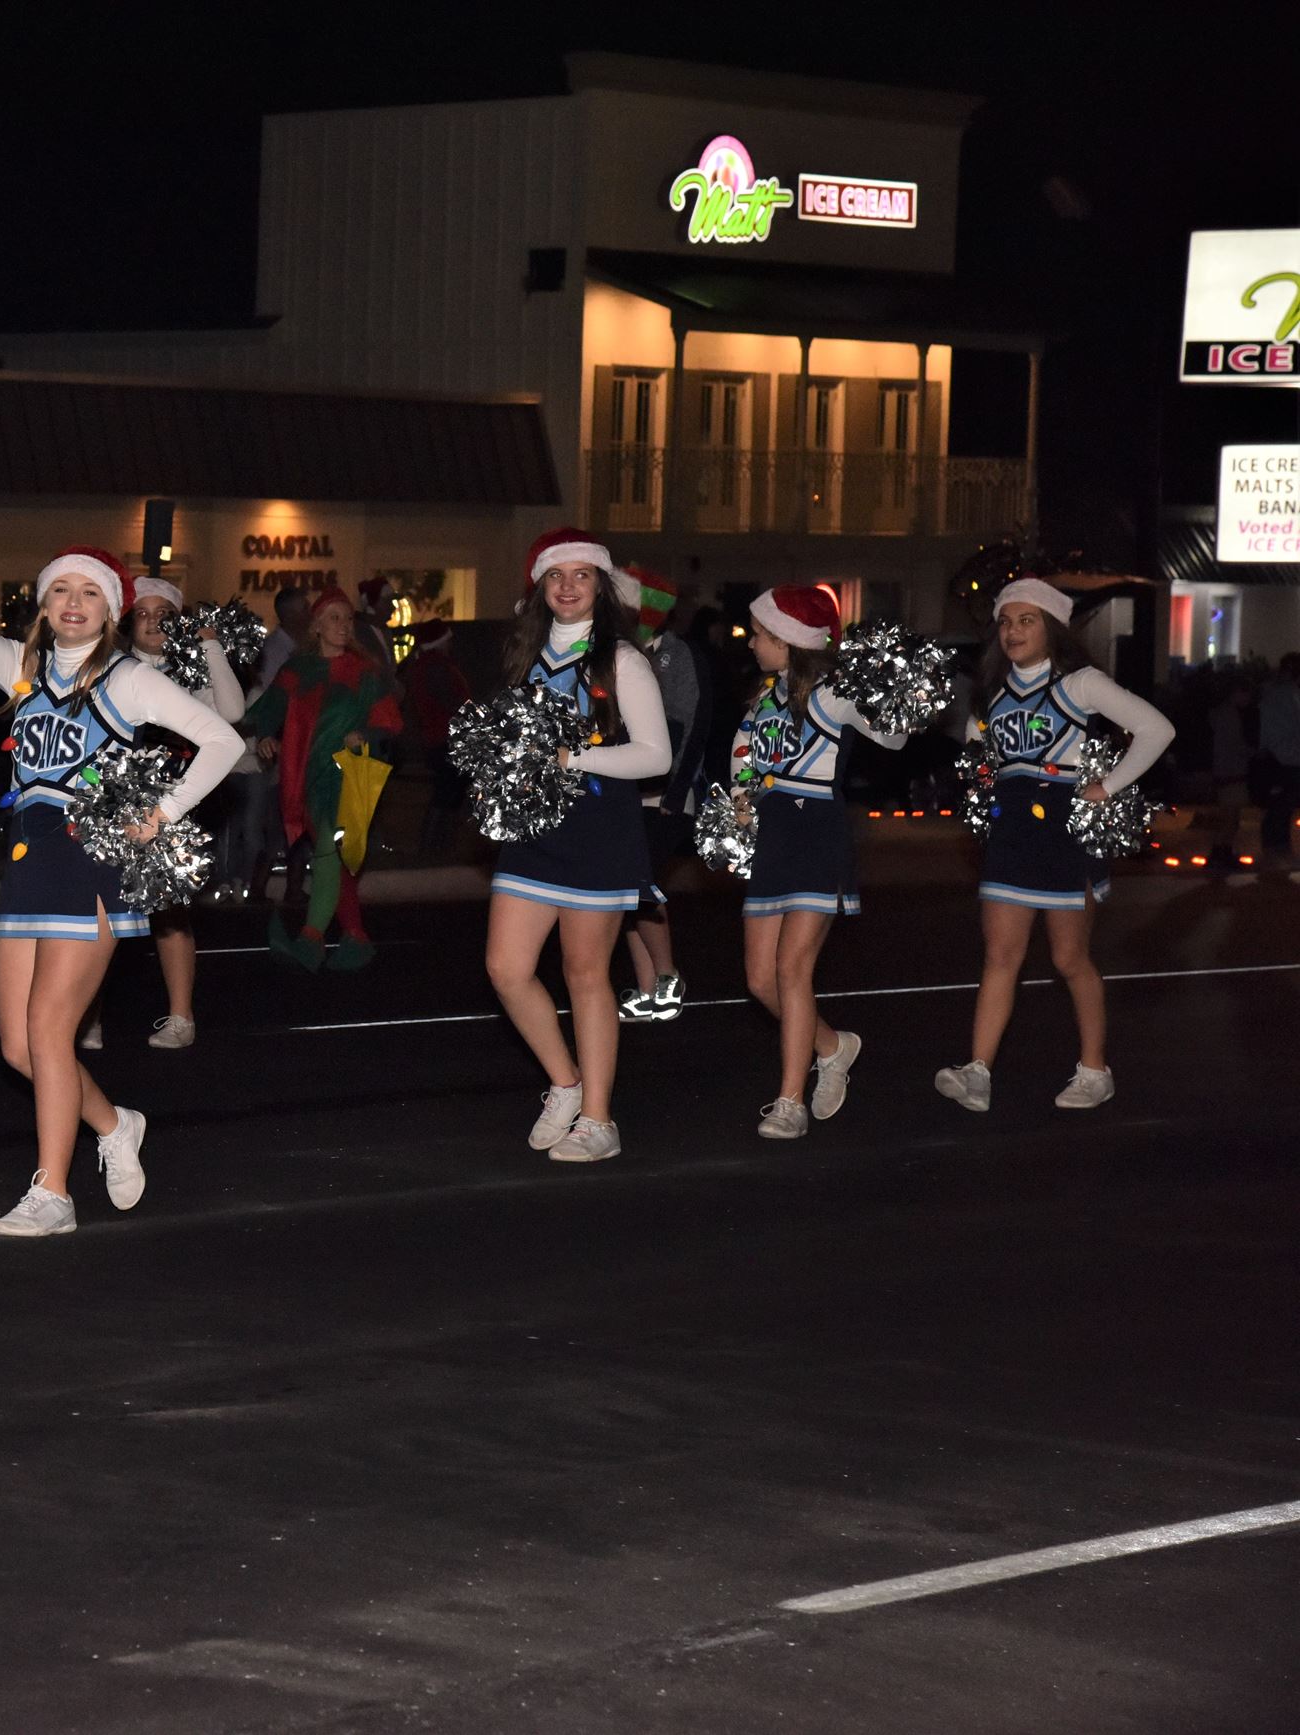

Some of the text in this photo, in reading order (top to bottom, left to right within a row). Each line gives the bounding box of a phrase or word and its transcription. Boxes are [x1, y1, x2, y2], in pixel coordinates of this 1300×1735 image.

[805, 183, 909, 220] ICE CREAM
[1208, 344, 1293, 372] ICE
[1232, 458, 1258, 473] ICE
[1235, 479, 1294, 494] MALTS
[1258, 500, 1300, 515] BAN
[1238, 519, 1293, 534] Voted
[242, 534, 334, 560] COASTAL
[1247, 538, 1275, 552] ICE
[990, 708, 1056, 755] GSMS
